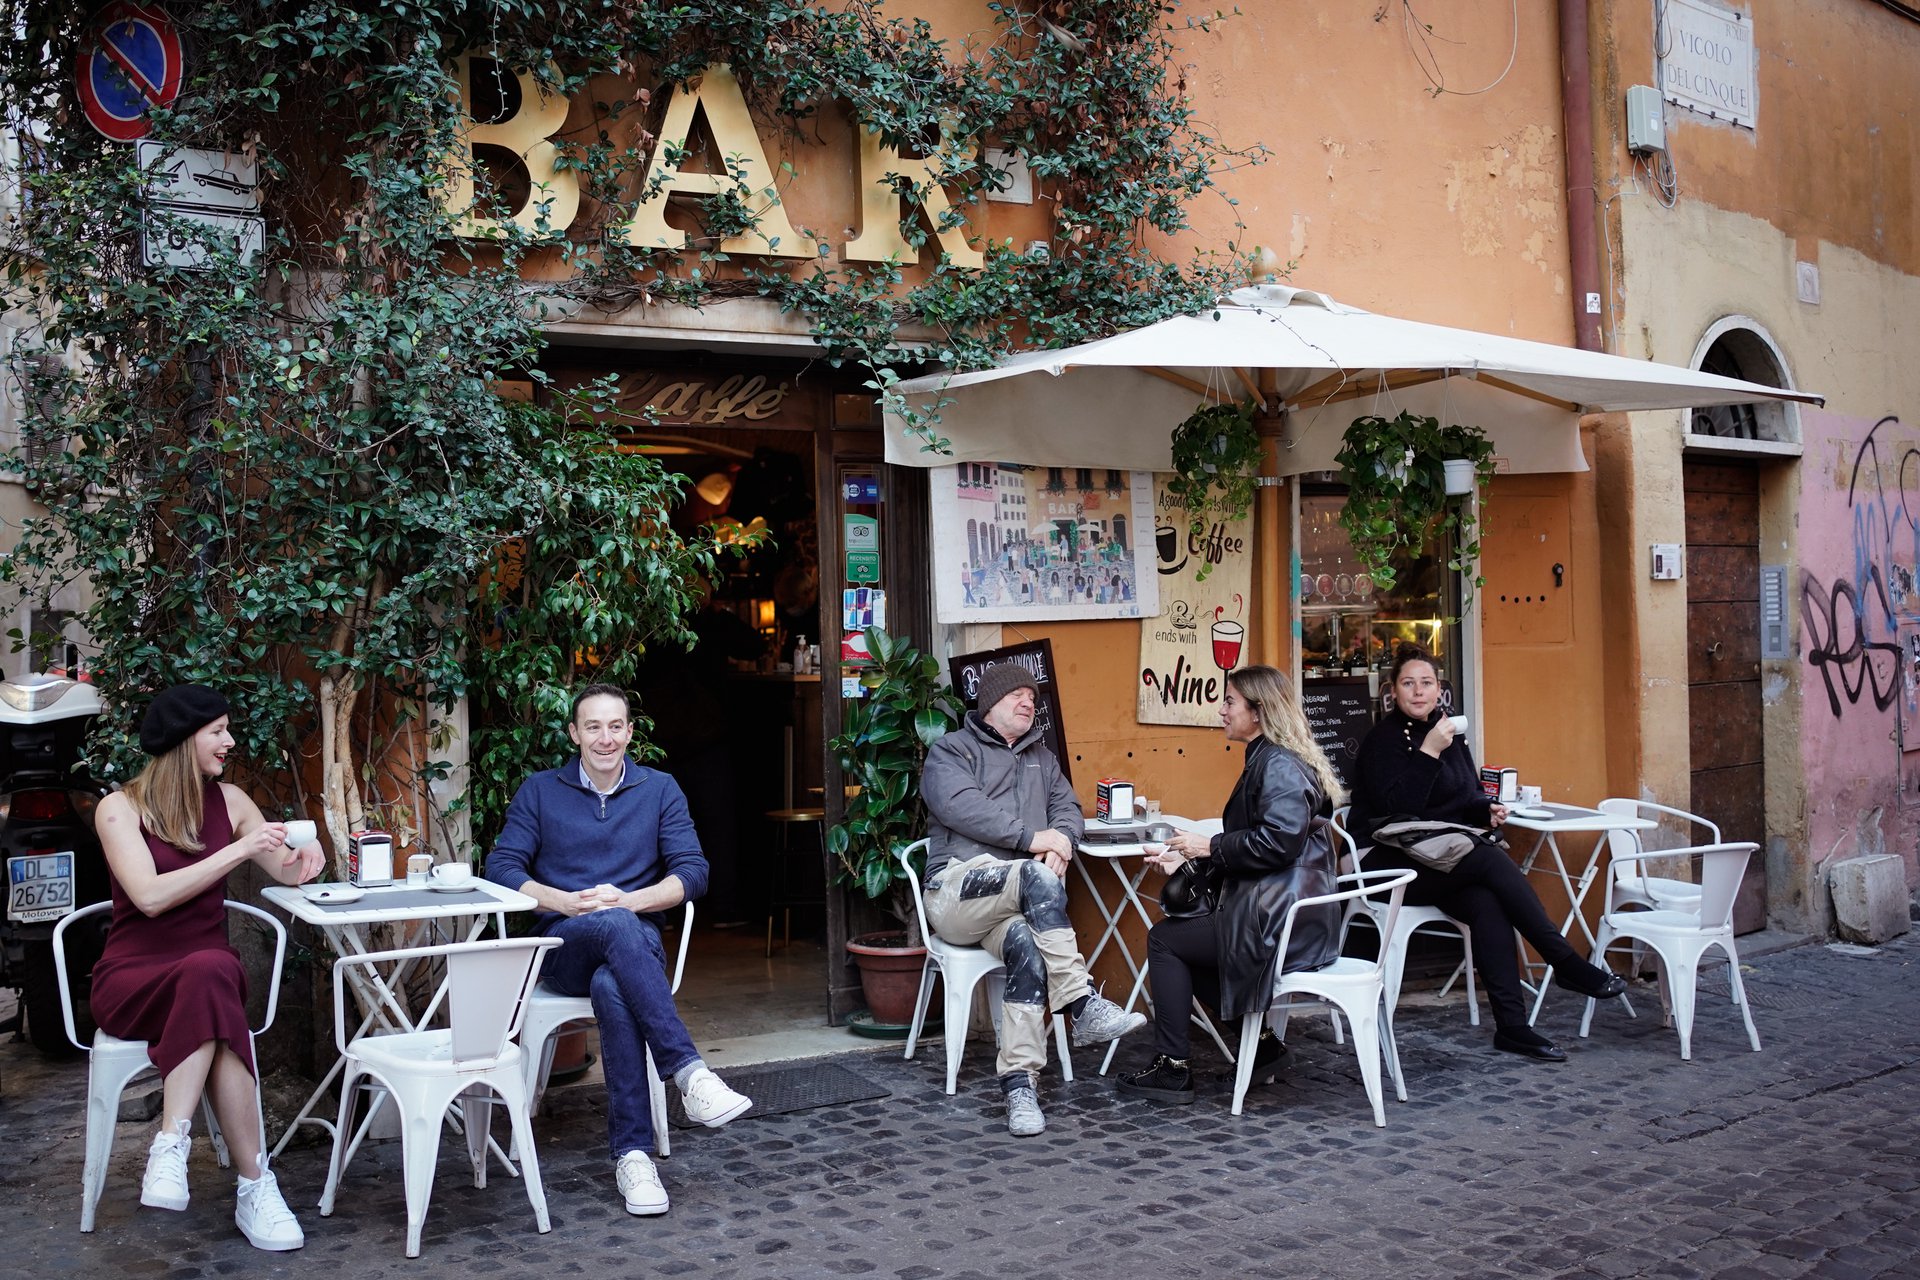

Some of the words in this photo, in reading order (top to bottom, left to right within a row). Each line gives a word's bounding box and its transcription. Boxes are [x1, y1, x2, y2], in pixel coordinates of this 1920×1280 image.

[1680, 29, 1732, 66] VICOLO
[1667, 63, 1691, 90] DEL
[1694, 74, 1747, 109] CINQUE
[430, 47, 985, 270] BAR
[1048, 502, 1076, 515] BAR
[1187, 521, 1244, 565] Coffee
[1155, 628, 1178, 643] ends
[1179, 630, 1197, 644] with
[1142, 654, 1219, 708] Wine
[1301, 693, 1330, 704] NEGRONI
[1311, 728, 1339, 740] ARGARITA
[26, 860, 47, 880] DL
[58, 866, 69, 876] VR
[15, 882, 70, 908] 26752
